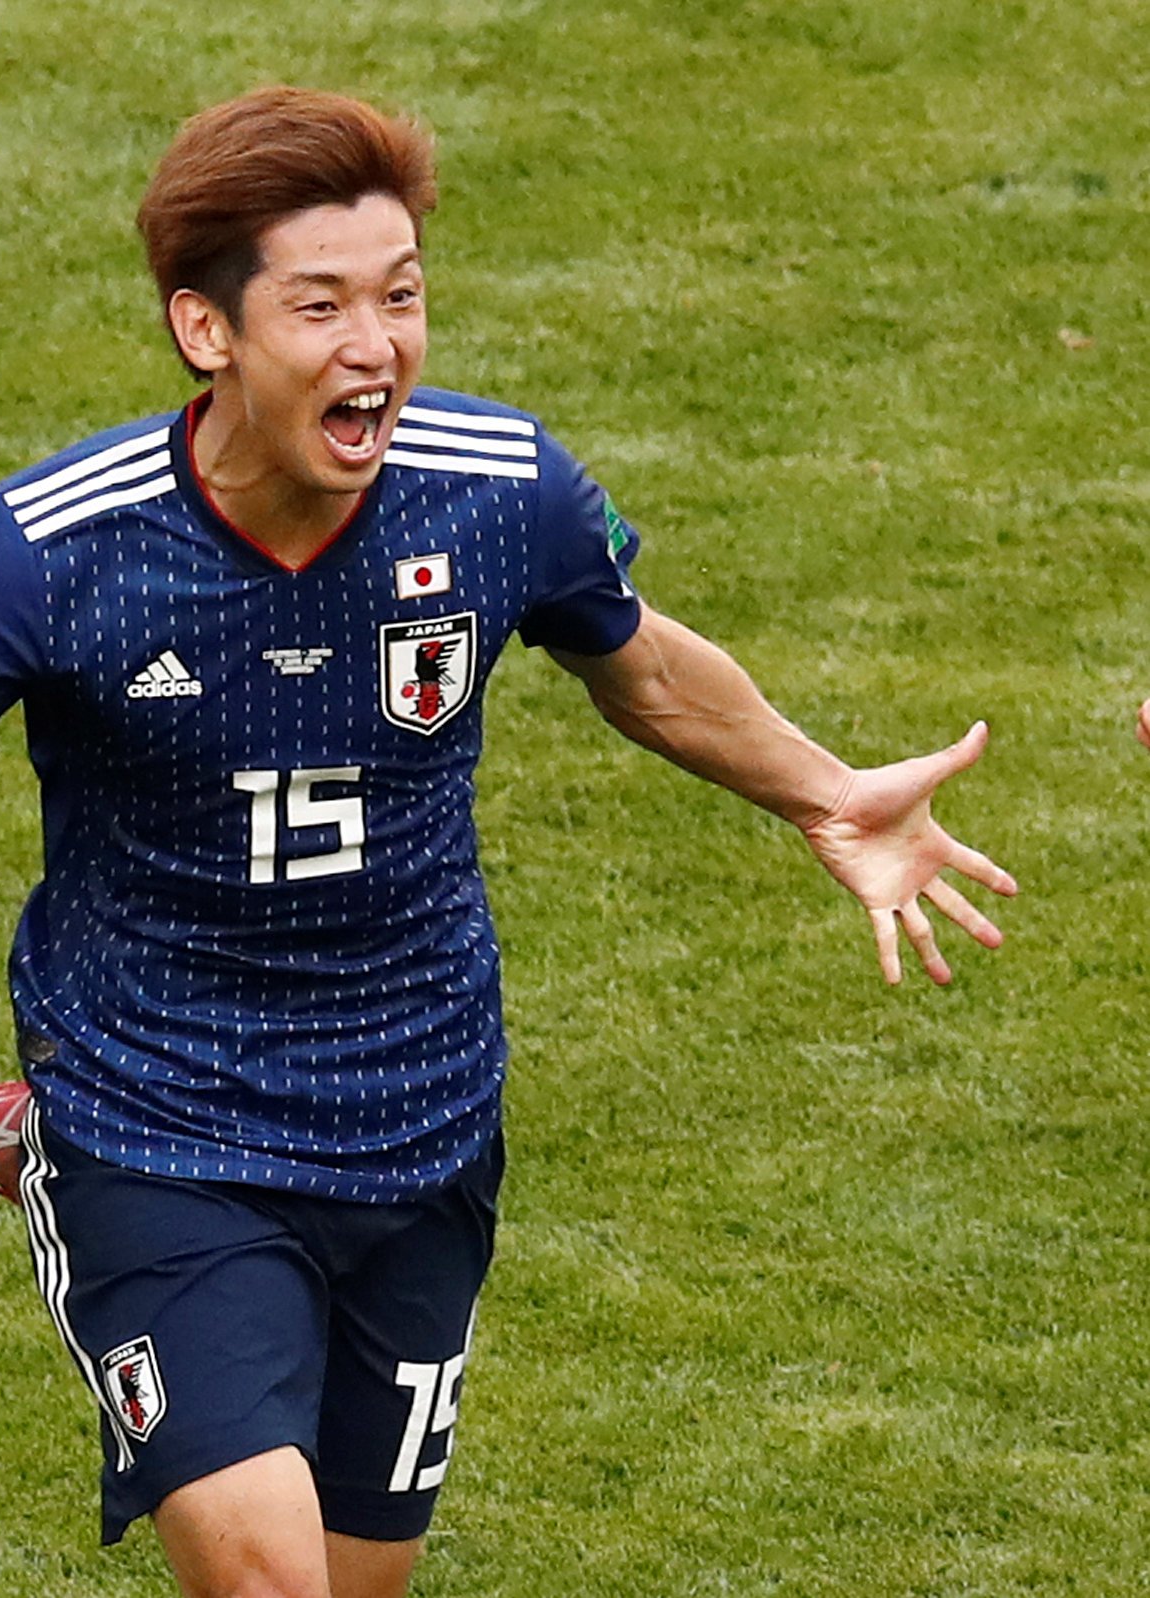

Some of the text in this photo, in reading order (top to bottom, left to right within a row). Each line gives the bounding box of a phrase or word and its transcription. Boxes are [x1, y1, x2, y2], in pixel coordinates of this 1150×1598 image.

[405, 621, 453, 637] JAPAN
[126, 680, 203, 698] adidas
[232, 765, 365, 884] 15
[388, 1352, 465, 1492] 15
